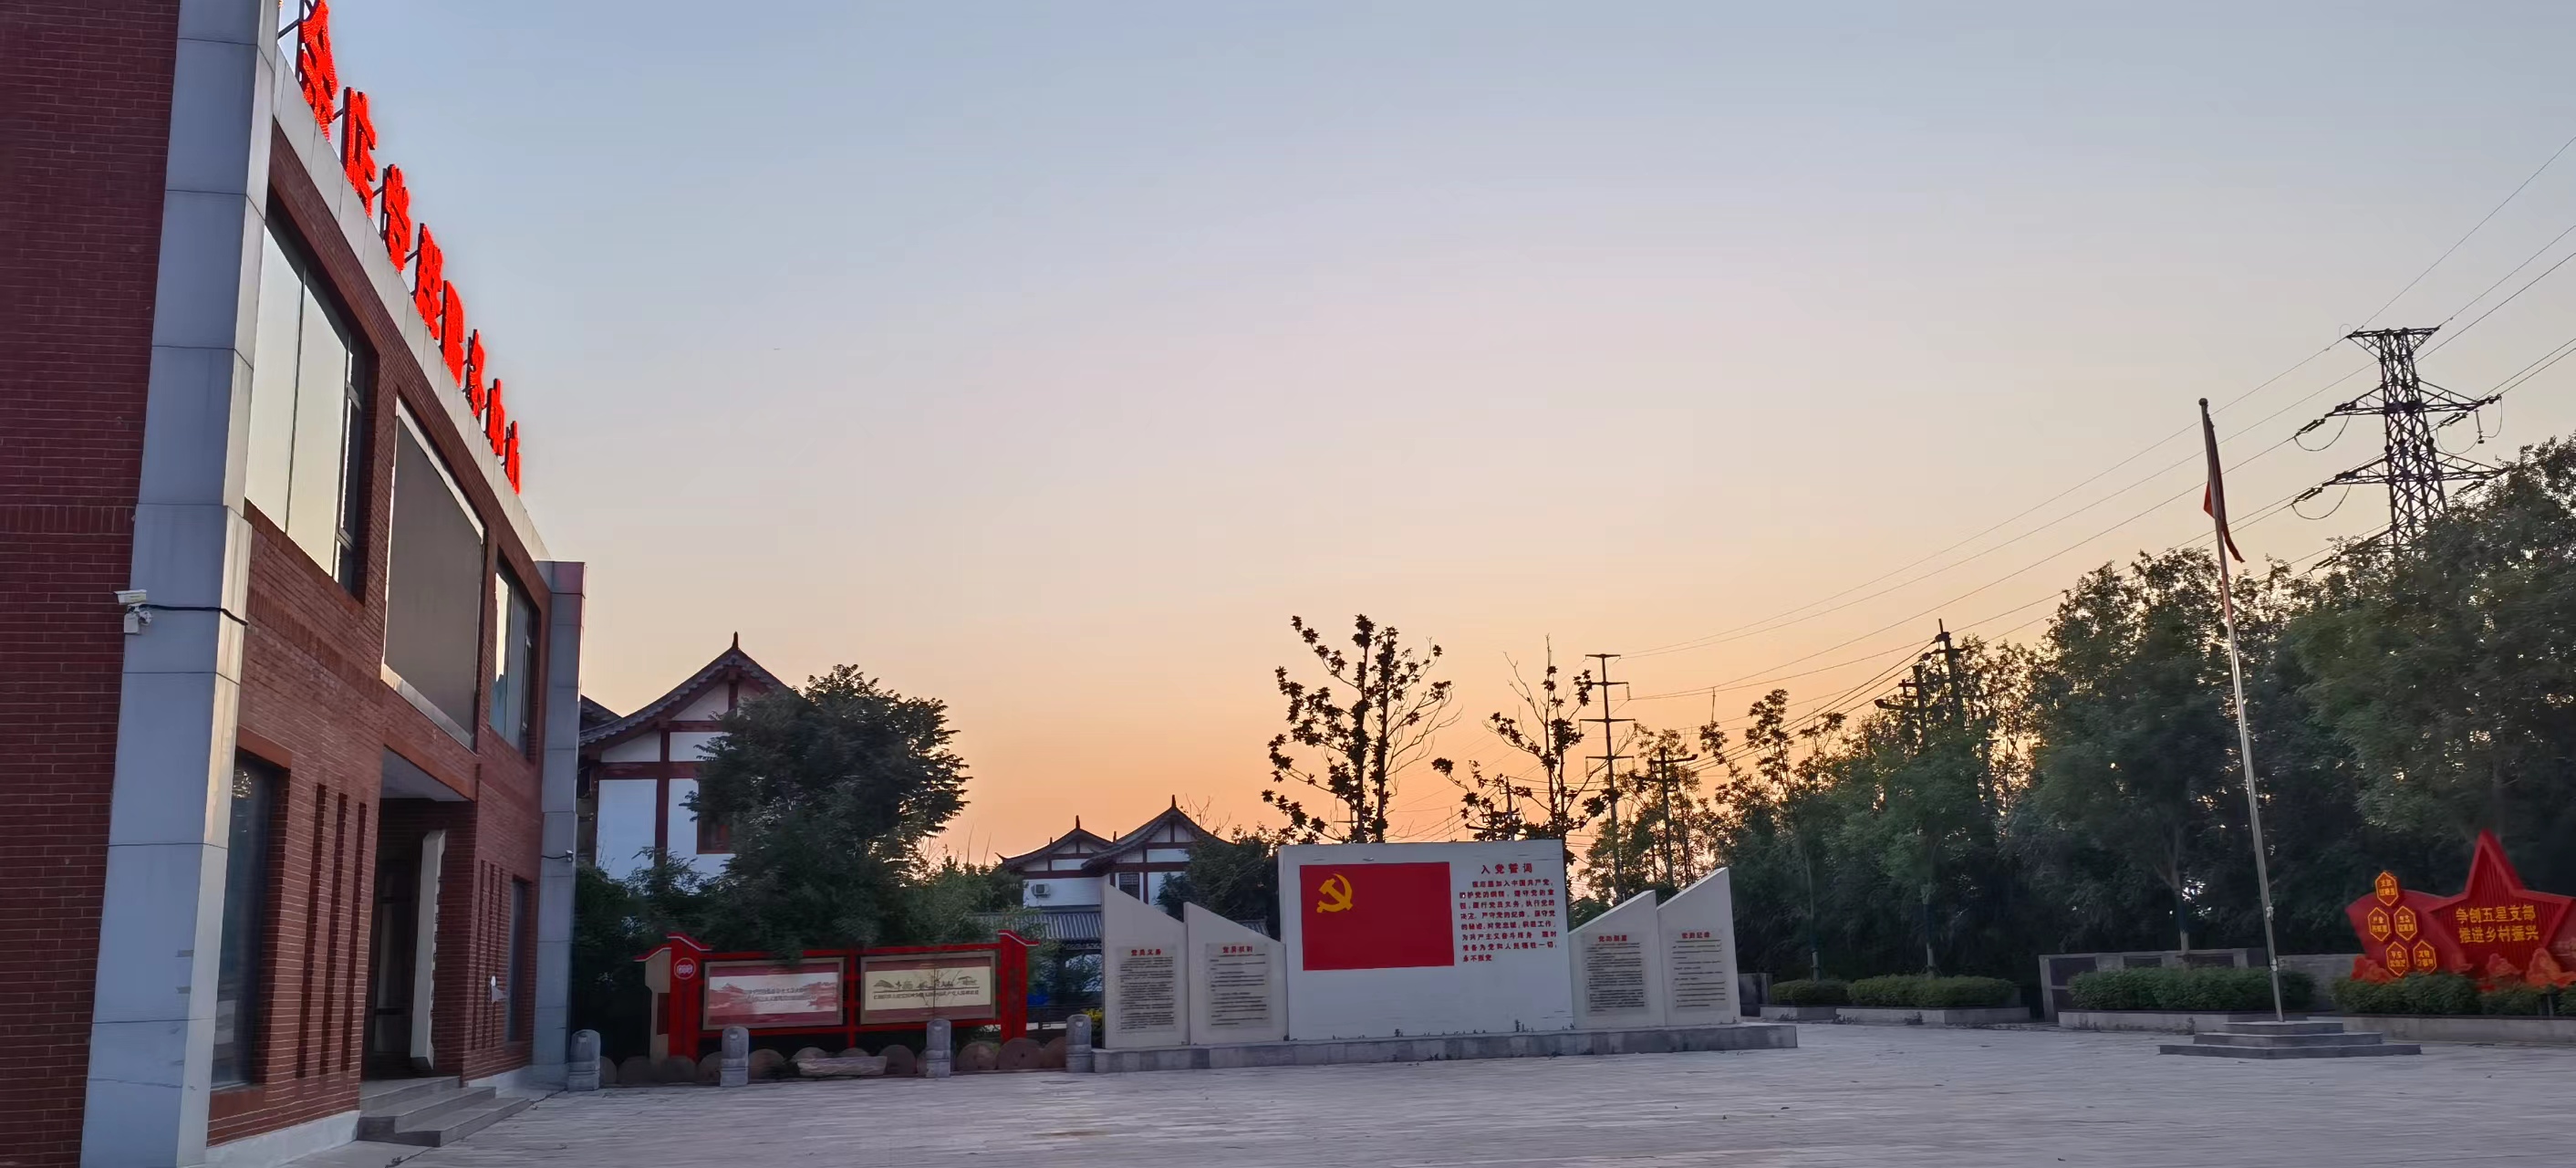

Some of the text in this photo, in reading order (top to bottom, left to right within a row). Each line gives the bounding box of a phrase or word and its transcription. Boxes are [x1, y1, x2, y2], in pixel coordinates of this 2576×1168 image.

[1480, 863, 1532, 874] 入党誓词
[2456, 904, 2537, 923] 争创五星支部
[2459, 924, 2540, 943] 推进乡村振兴
[1131, 948, 1161, 956] 党员义务
